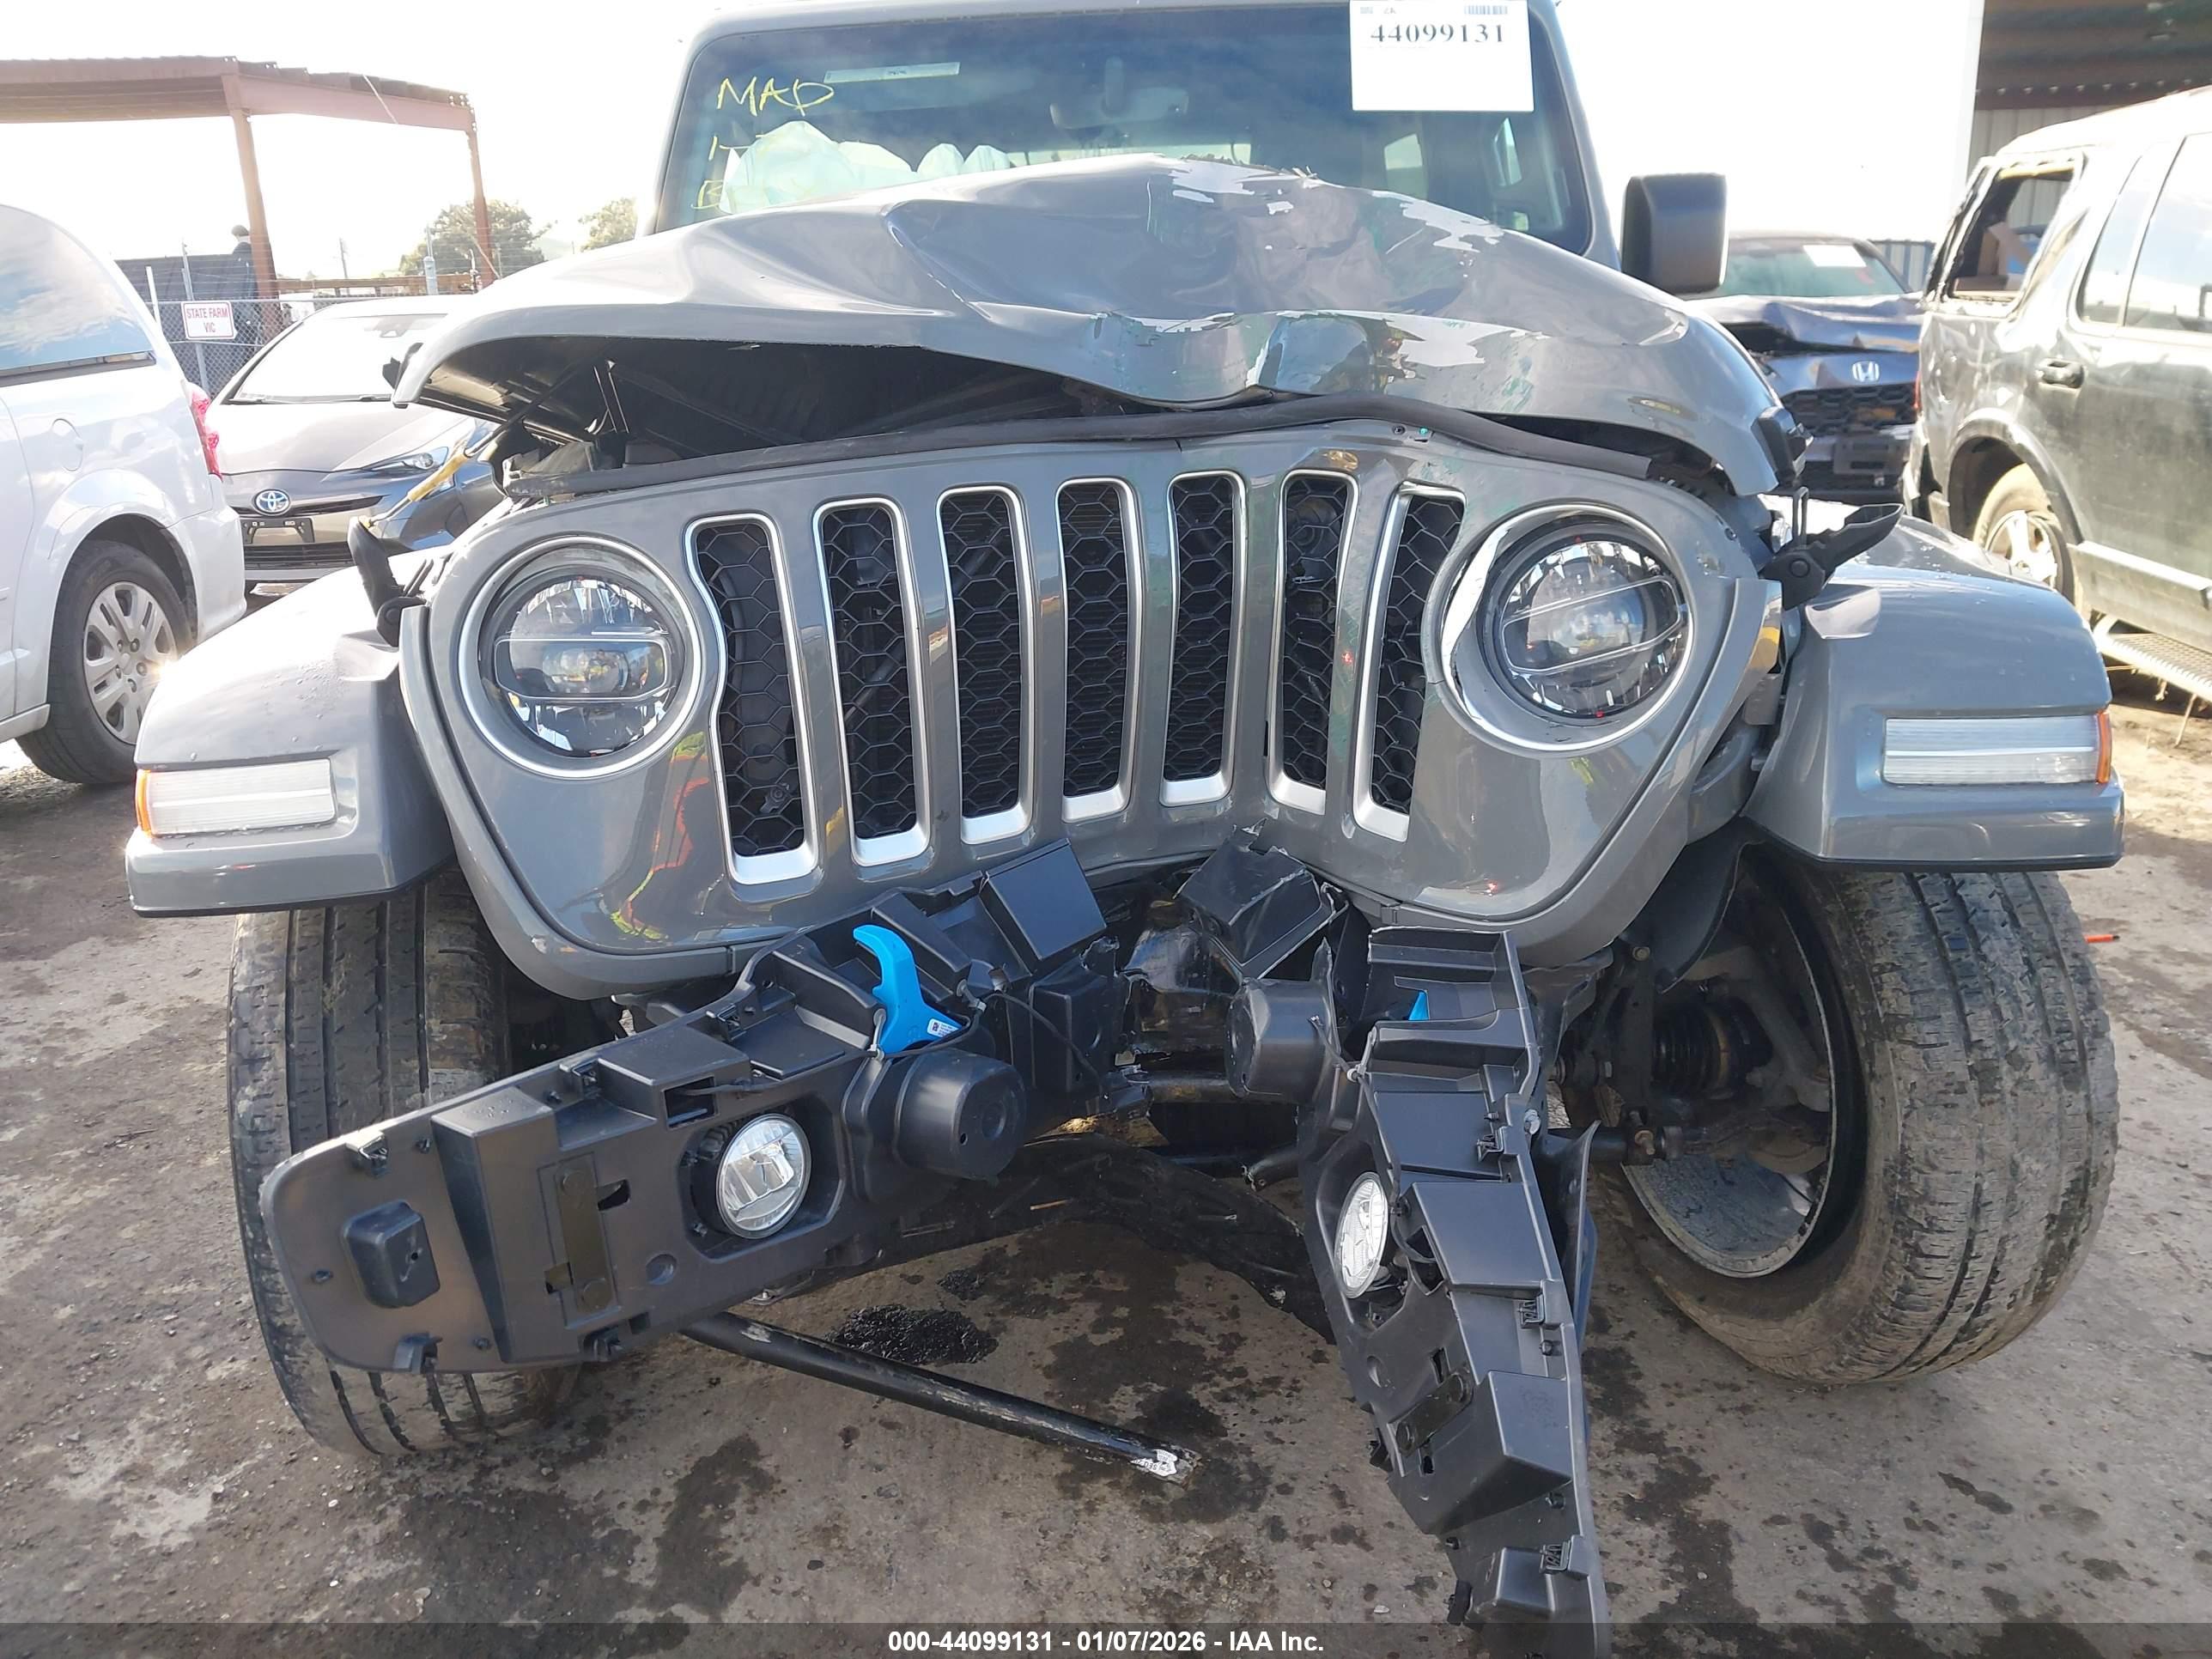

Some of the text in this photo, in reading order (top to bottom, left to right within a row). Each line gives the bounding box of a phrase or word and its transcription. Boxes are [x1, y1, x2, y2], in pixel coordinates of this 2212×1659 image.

[1370, 23, 1504, 43] 44099131
[186, 307, 228, 319] STATE FARM
[204, 322, 216, 332] VIC
